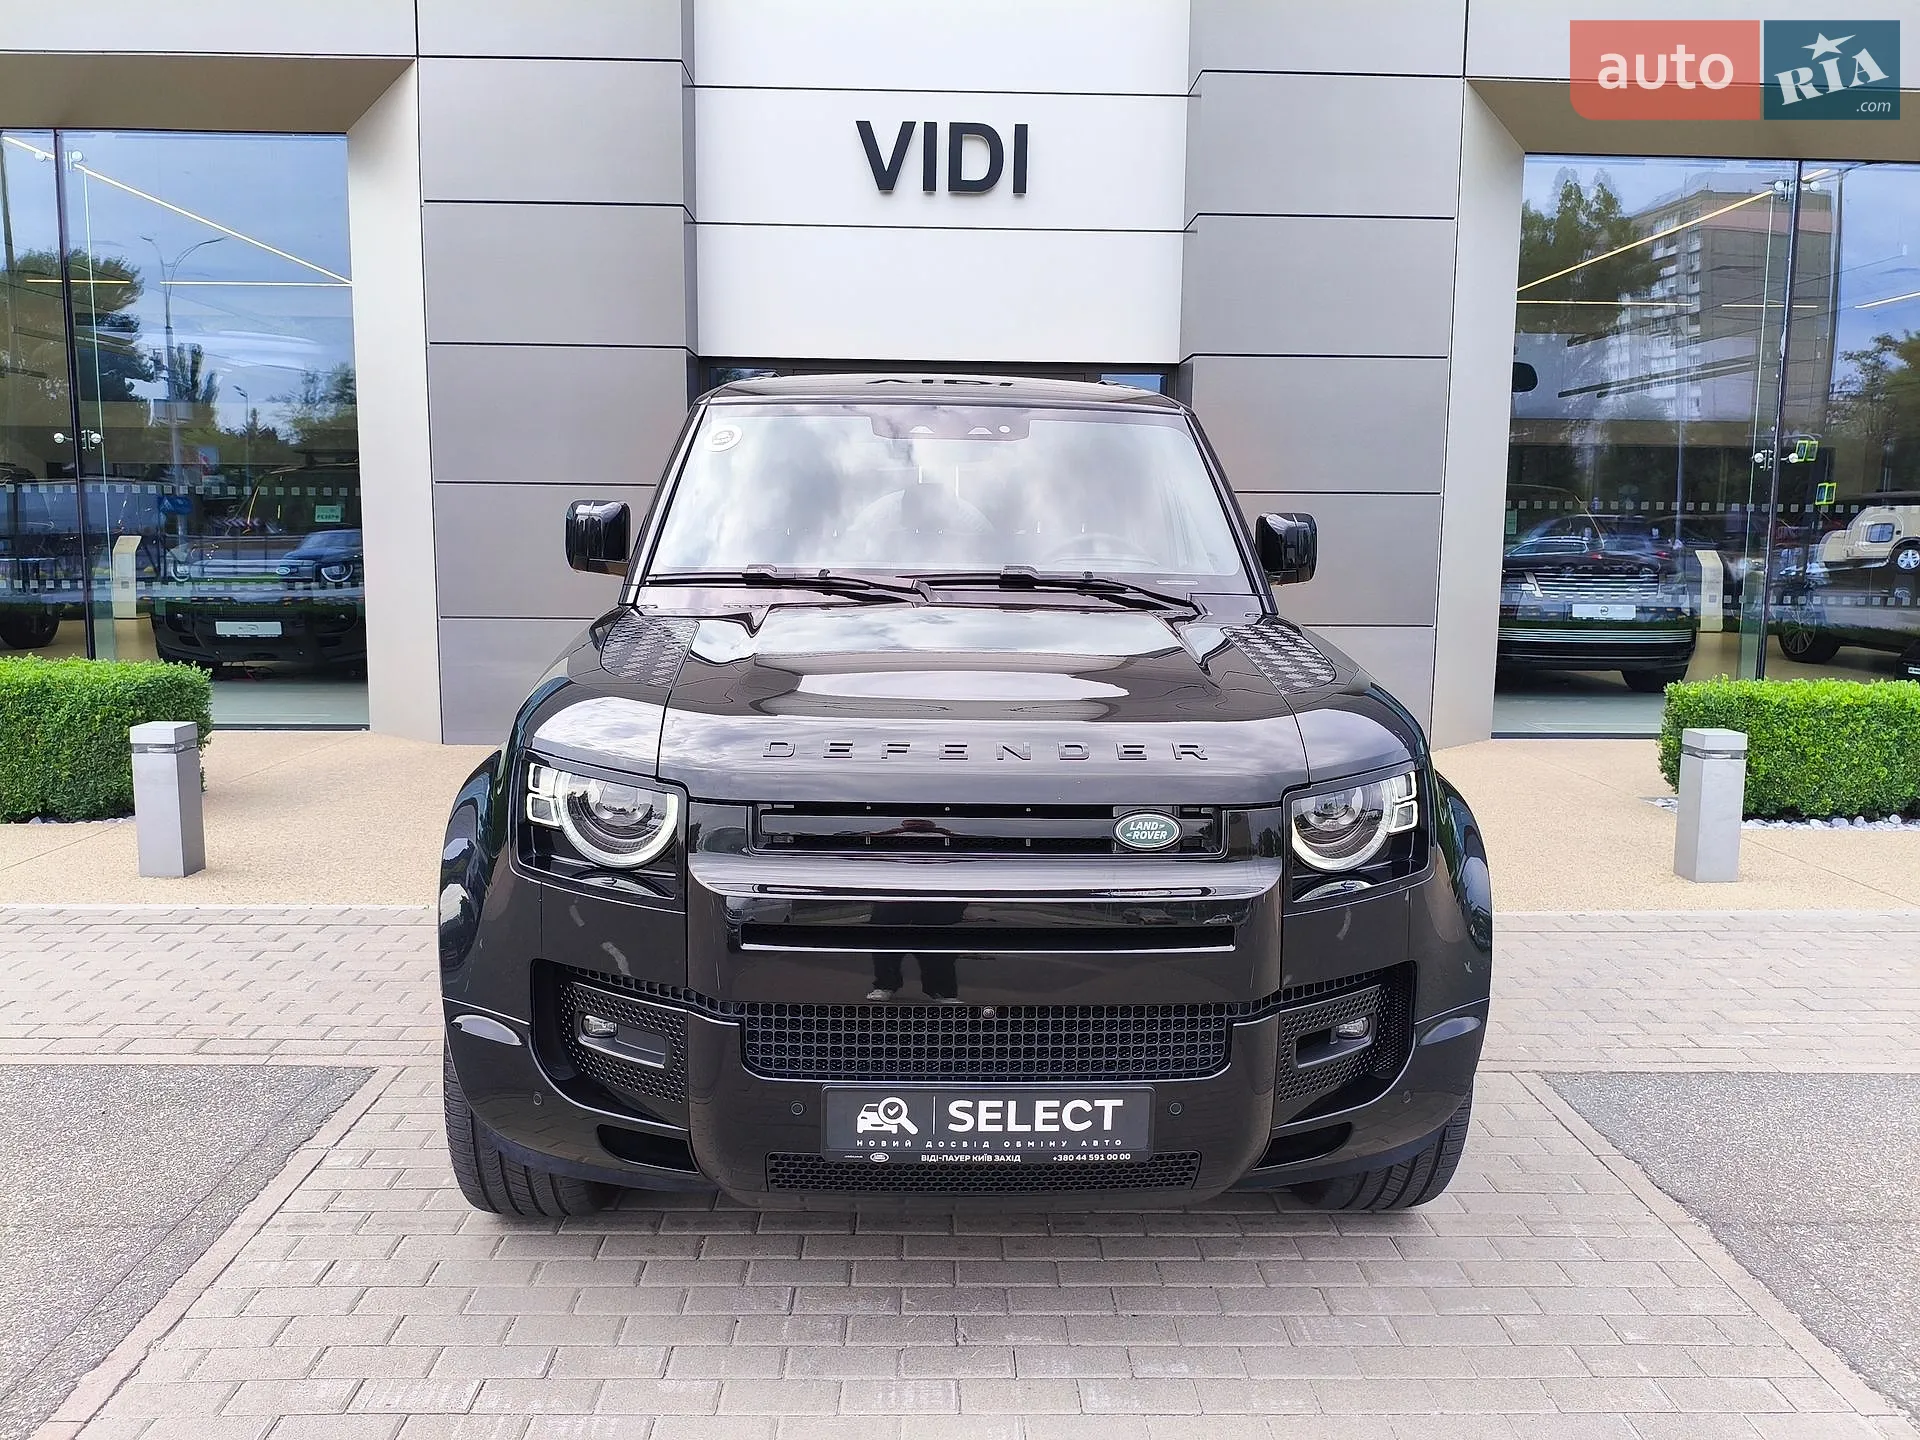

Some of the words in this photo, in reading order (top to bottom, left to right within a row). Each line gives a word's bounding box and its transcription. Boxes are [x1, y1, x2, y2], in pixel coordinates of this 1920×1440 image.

[855, 120, 1029, 194] VIDI
[762, 740, 1208, 761] DEFENDER
[1130, 821, 1158, 831] LAND
[1132, 830, 1168, 840] ROVER
[947, 1099, 1124, 1133] SELECT
[856, 1139, 912, 1148] НОВИЙ
[925, 1139, 990, 1149] ДОСВІД
[1003, 1139, 1068, 1148] ОБМІНУ
[1080, 1138, 1122, 1147] АВТО
[972, 1153, 992, 1162] КИЇВ
[994, 1153, 1021, 1163] ЗАХІД
[1053, 1153, 1074, 1162] +380
[1075, 1153, 1087, 1161] 44
[1088, 1153, 1105, 1161] 591
[1106, 1153, 1118, 1161] 00
[1119, 1152, 1131, 1160] 00
